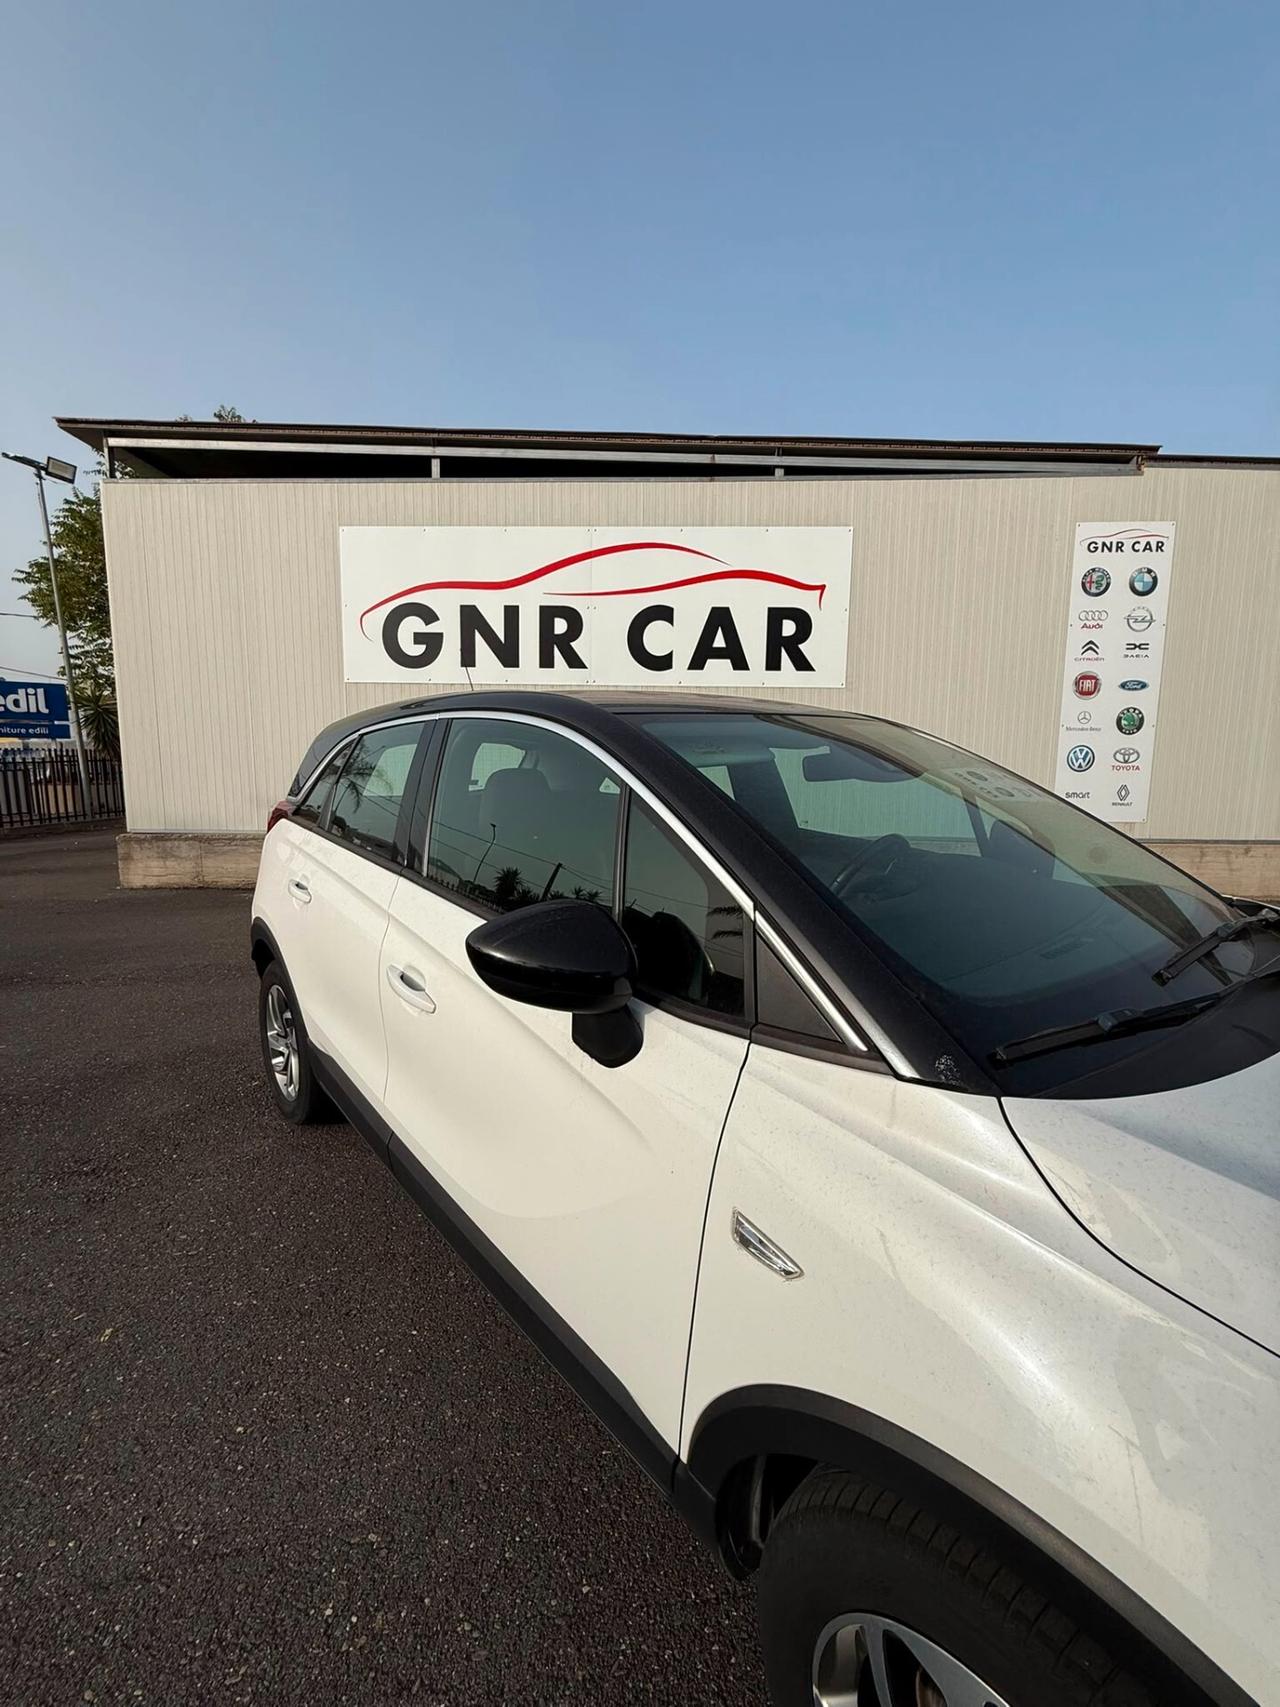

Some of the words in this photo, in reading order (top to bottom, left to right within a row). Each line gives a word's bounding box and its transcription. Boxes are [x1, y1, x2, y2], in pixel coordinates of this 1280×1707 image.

[1087, 541, 1124, 553] GNR
[1132, 540, 1165, 553] CAR
[1080, 622, 1103, 630] Audi
[381, 602, 588, 670] GNR
[627, 604, 816, 672] CAR
[1079, 678, 1097, 692] FIAT
[1124, 681, 1143, 690] Ford
[1065, 791, 1091, 799] smart
